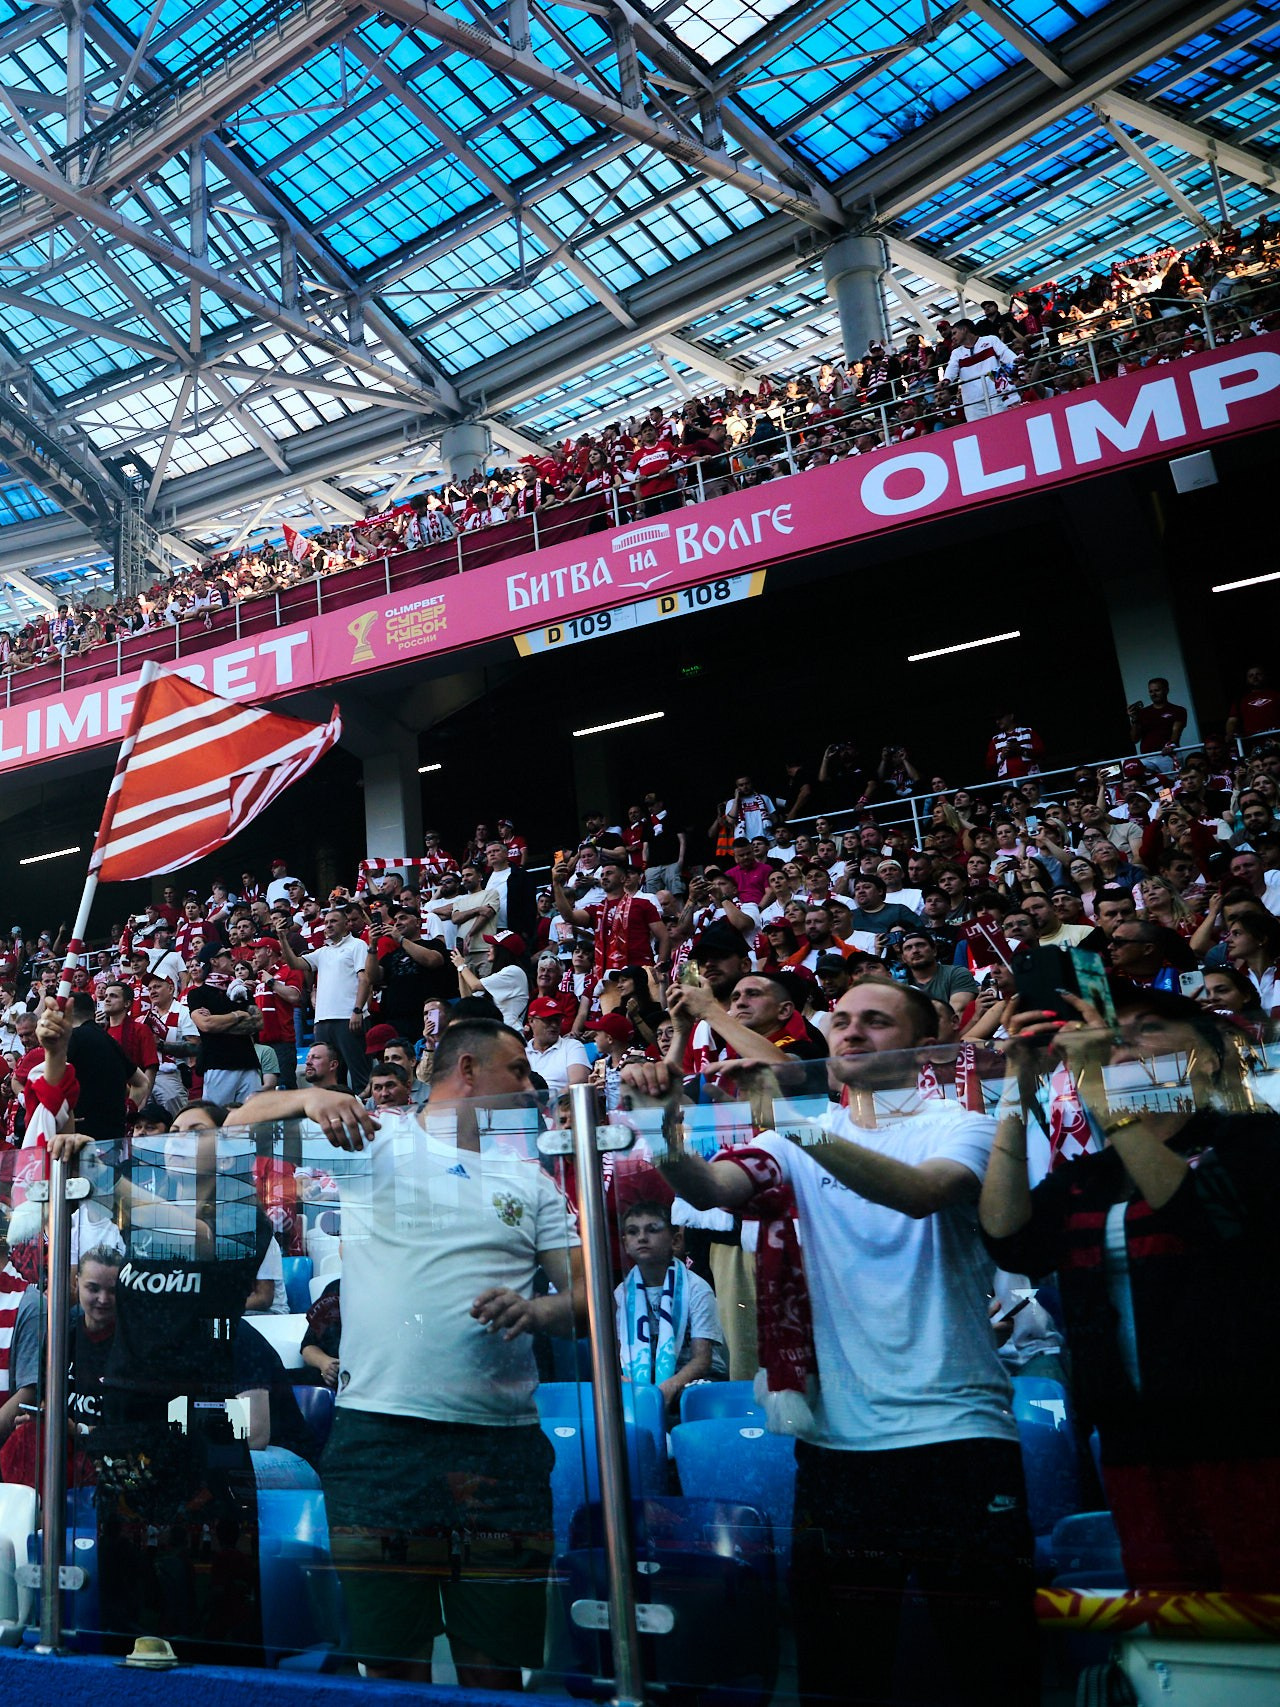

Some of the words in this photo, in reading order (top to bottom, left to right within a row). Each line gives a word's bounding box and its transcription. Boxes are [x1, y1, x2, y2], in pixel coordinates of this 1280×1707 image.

[384, 594, 445, 618] OLIMPBET
[661, 597, 675, 613] D
[683, 580, 731, 608] 108
[386, 604, 446, 631] СУПЕР
[387, 617, 447, 645] КУБОК
[548, 627, 562, 644] D
[568, 612, 612, 638] 109
[398, 634, 437, 650] РОССИИ
